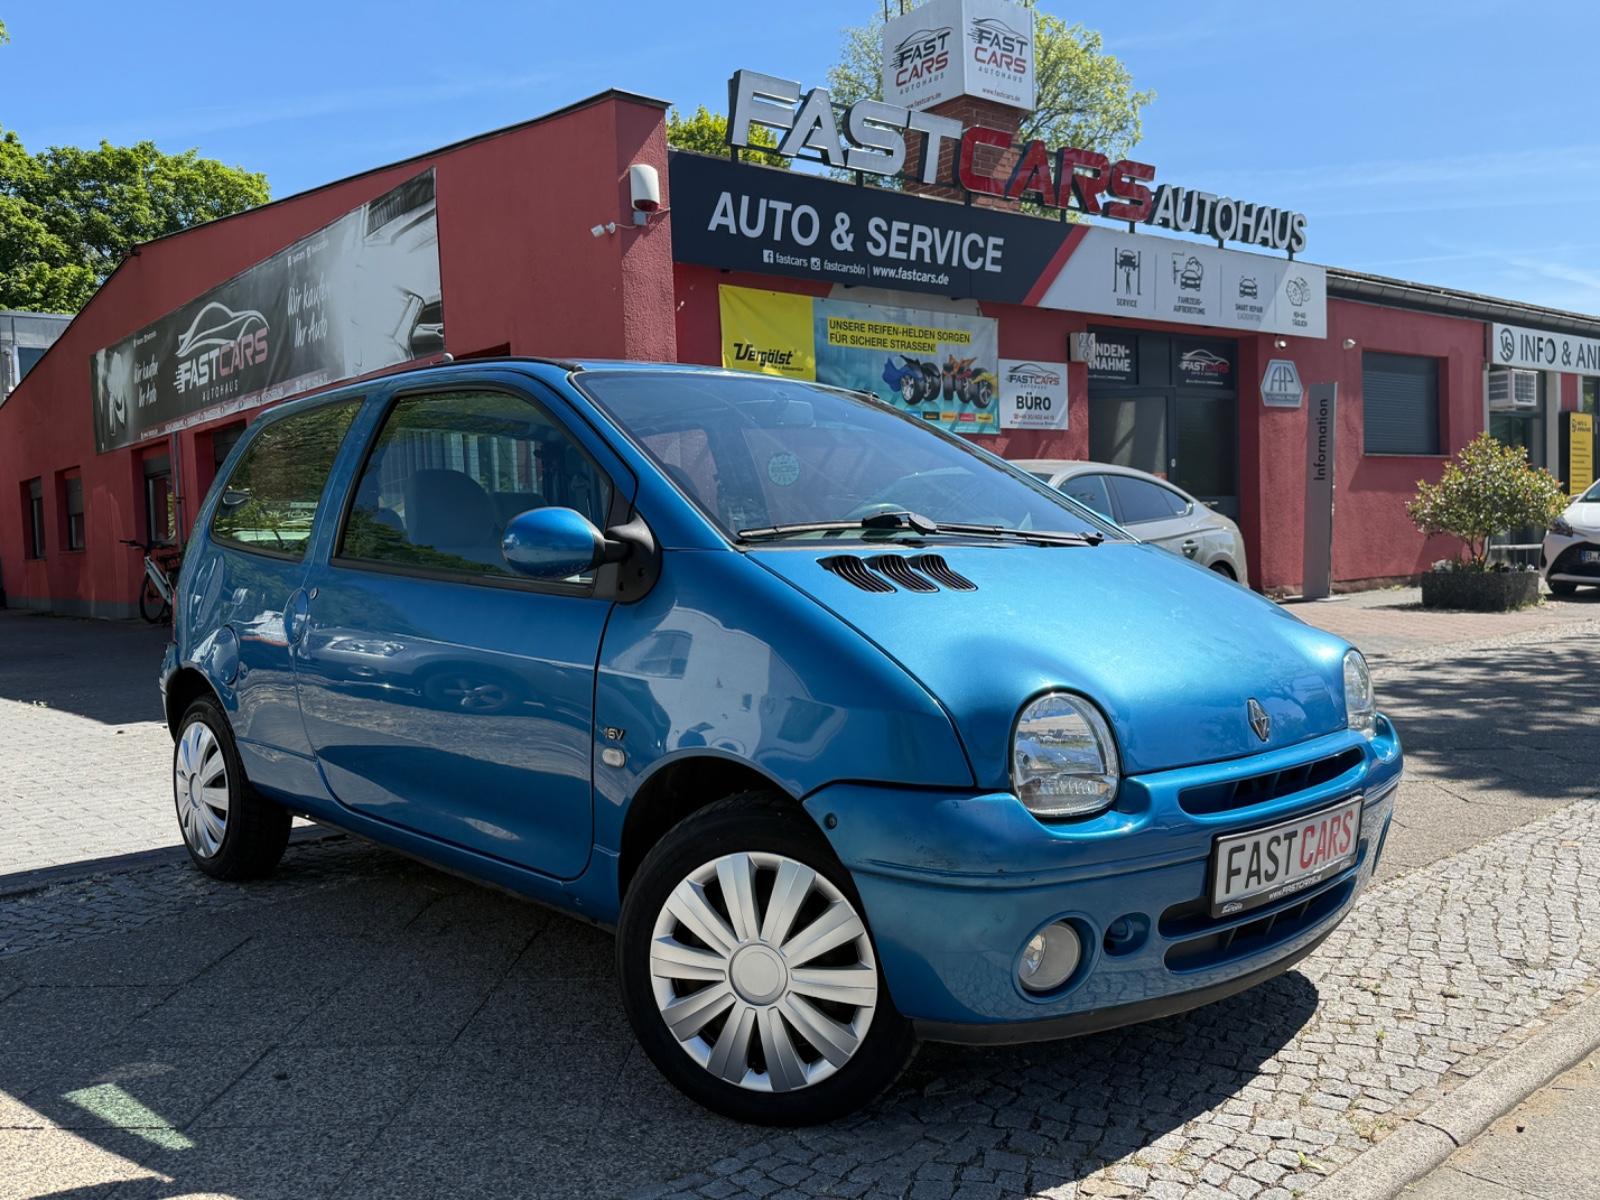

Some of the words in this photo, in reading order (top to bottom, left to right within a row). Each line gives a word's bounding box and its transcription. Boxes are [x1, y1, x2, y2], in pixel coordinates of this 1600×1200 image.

[898, 31, 950, 67] FAST
[975, 27, 1028, 56] FAST
[896, 51, 949, 87] CARS
[974, 46, 1027, 75] CARS
[707, 191, 820, 247] AUTO
[830, 211, 854, 253] &
[866, 216, 1005, 273] SERVICE
[1152, 184, 1307, 253] AUTOHAUS
[775, 252, 808, 268] fastcars
[872, 265, 950, 286] www.fastcars.de
[1116, 298, 1138, 308] SERVICE
[829, 319, 865, 333] UNSERE
[867, 323, 936, 340] REIFEN-HELDEN
[937, 331, 971, 344] SORGEN
[829, 332, 848, 345] FÜR
[850, 336, 889, 348] SICHERE
[177, 327, 268, 393] FASTCARS
[734, 343, 793, 367] Vergölst
[1095, 343, 1130, 358] NDEN-
[1520, 333, 1556, 365] INFO
[1561, 340, 1571, 367] &
[1576, 343, 1600, 371] AN
[202, 379, 239, 401] AUTOHAUS
[1016, 391, 1052, 411] BÜRO
[1313, 398, 1329, 481] Information
